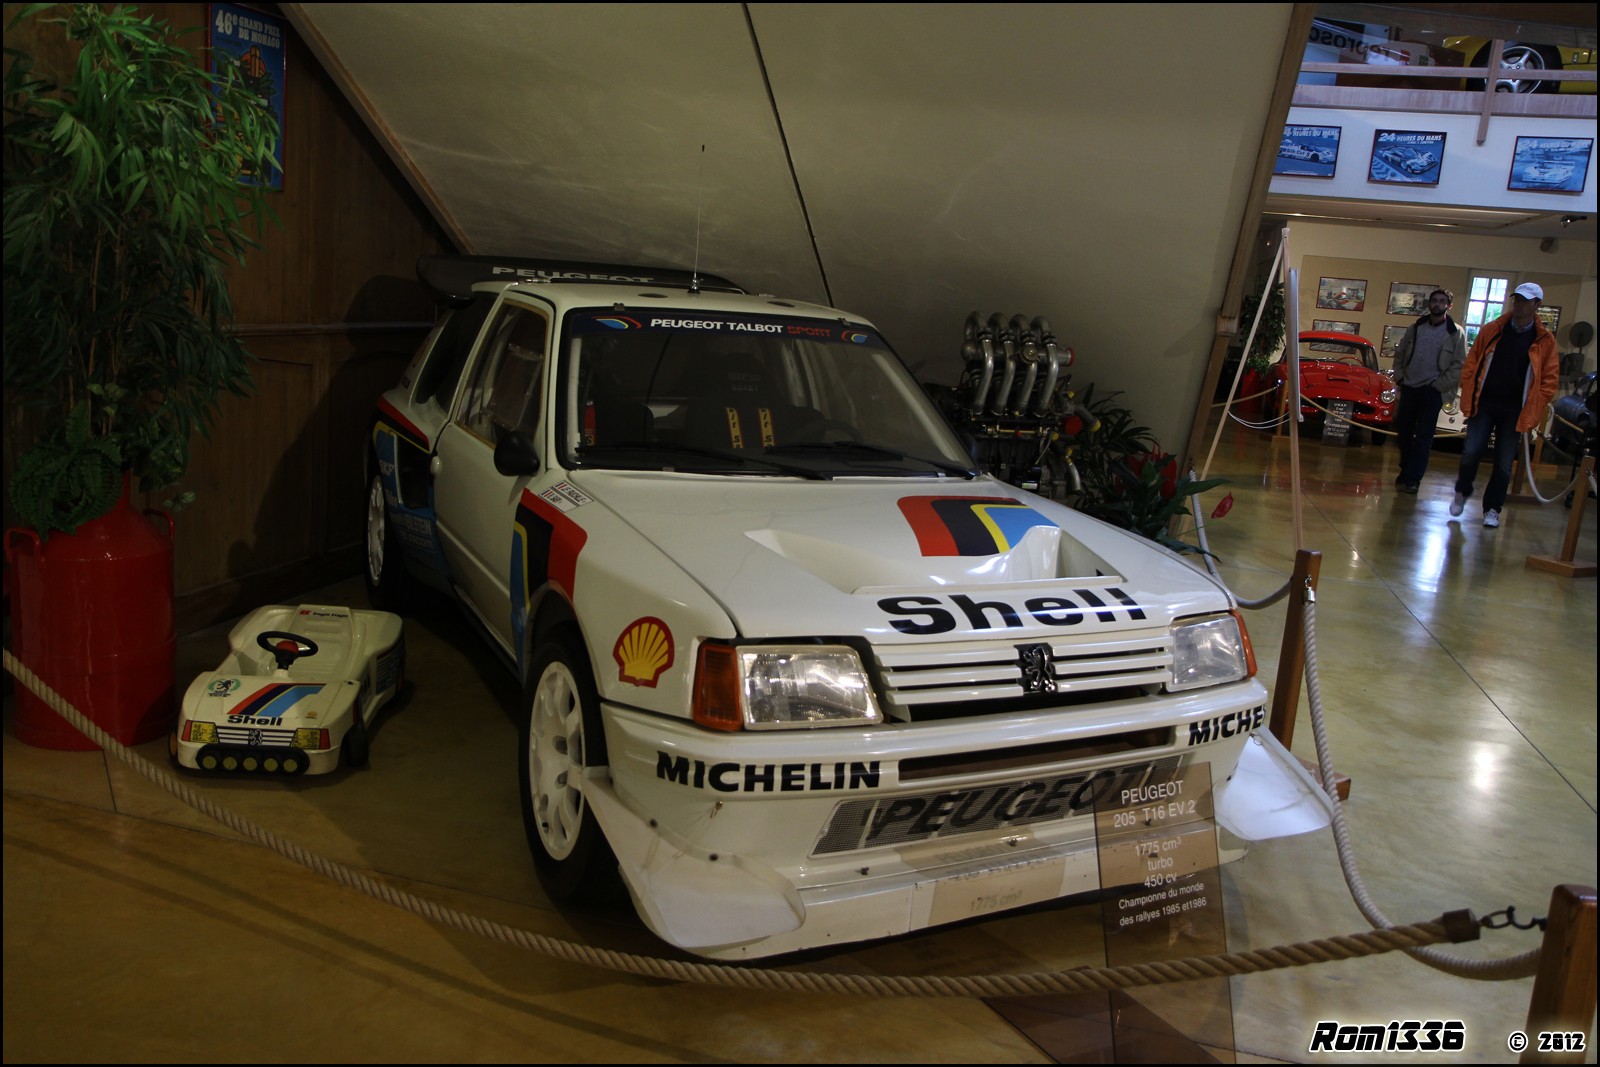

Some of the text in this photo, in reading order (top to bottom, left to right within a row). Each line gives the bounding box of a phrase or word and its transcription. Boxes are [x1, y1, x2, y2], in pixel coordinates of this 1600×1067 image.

[238, 27, 250, 41] DE
[251, 30, 281, 49] MONACO
[239, 16, 264, 33] GRAND
[264, 24, 281, 38] PRIX
[1378, 132, 1442, 142] 24 HEURES DU MANS
[492, 266, 654, 283] PEUGEOT
[650, 317, 832, 337] PEUGEOT TALBOT SPORT
[877, 587, 1147, 635] Shell
[227, 714, 283, 726] Shell
[1188, 704, 1266, 746] MICHE
[656, 750, 881, 792] MICHELIN
[864, 762, 1156, 841] PEUGEOT
[1120, 780, 1184, 805] PEUGEOT
[1113, 800, 1196, 828] 205 T16 EV.2
[1135, 841, 1160, 856] 1775
[1147, 857, 1173, 871] turbo
[1144, 872, 1178, 888] 450 cv
[1118, 882, 1205, 910] Championne du monde
[1119, 916, 1134, 926] des
[1135, 909, 1160, 923] rallyes
[1162, 903, 1181, 916] 1985
